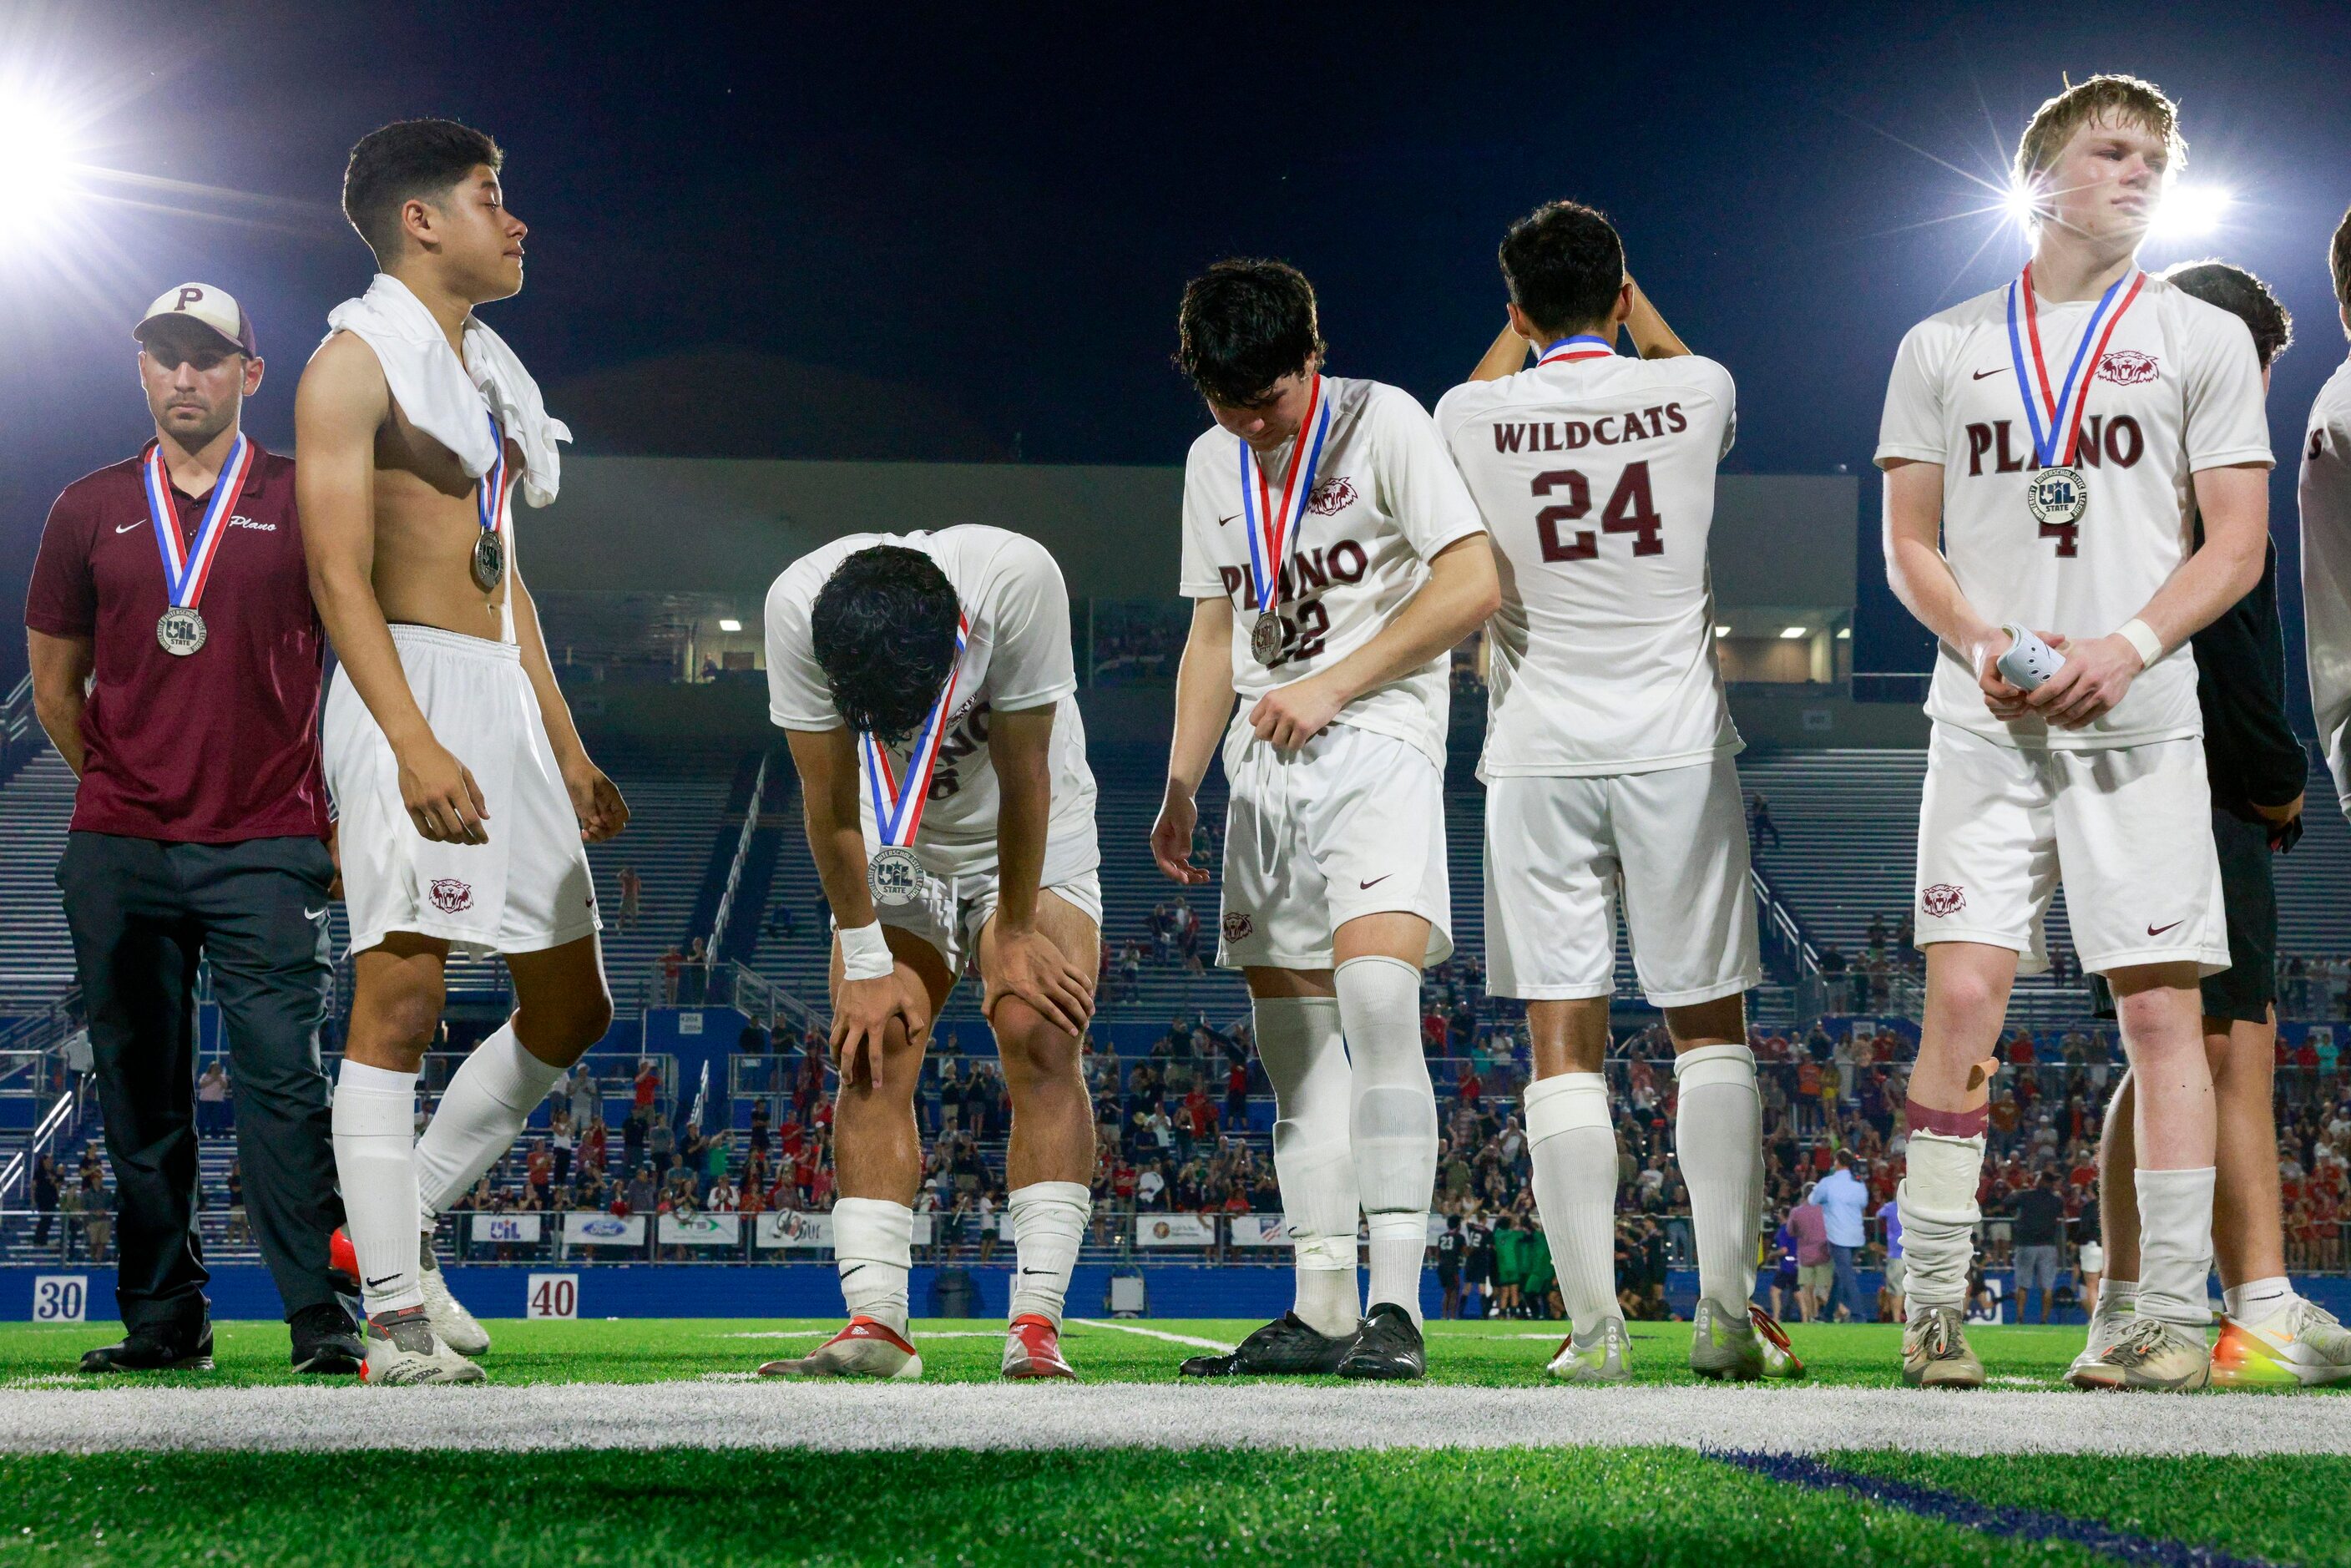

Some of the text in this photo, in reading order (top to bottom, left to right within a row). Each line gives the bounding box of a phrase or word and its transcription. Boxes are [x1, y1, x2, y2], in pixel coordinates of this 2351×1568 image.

[174, 287, 204, 311] P
[1493, 402, 1688, 454] WILDCATS
[2035, 469, 2086, 490] INTERSCHOLASTIC
[229, 514, 277, 532] Plano
[1530, 459, 1663, 563] 24
[1439, 1236, 1454, 1251] 23
[38, 1282, 82, 1318] 30
[532, 1280, 574, 1317] 40
[1699, 1308, 1709, 1338] COPA
[1608, 1326, 1618, 1358] COPA
